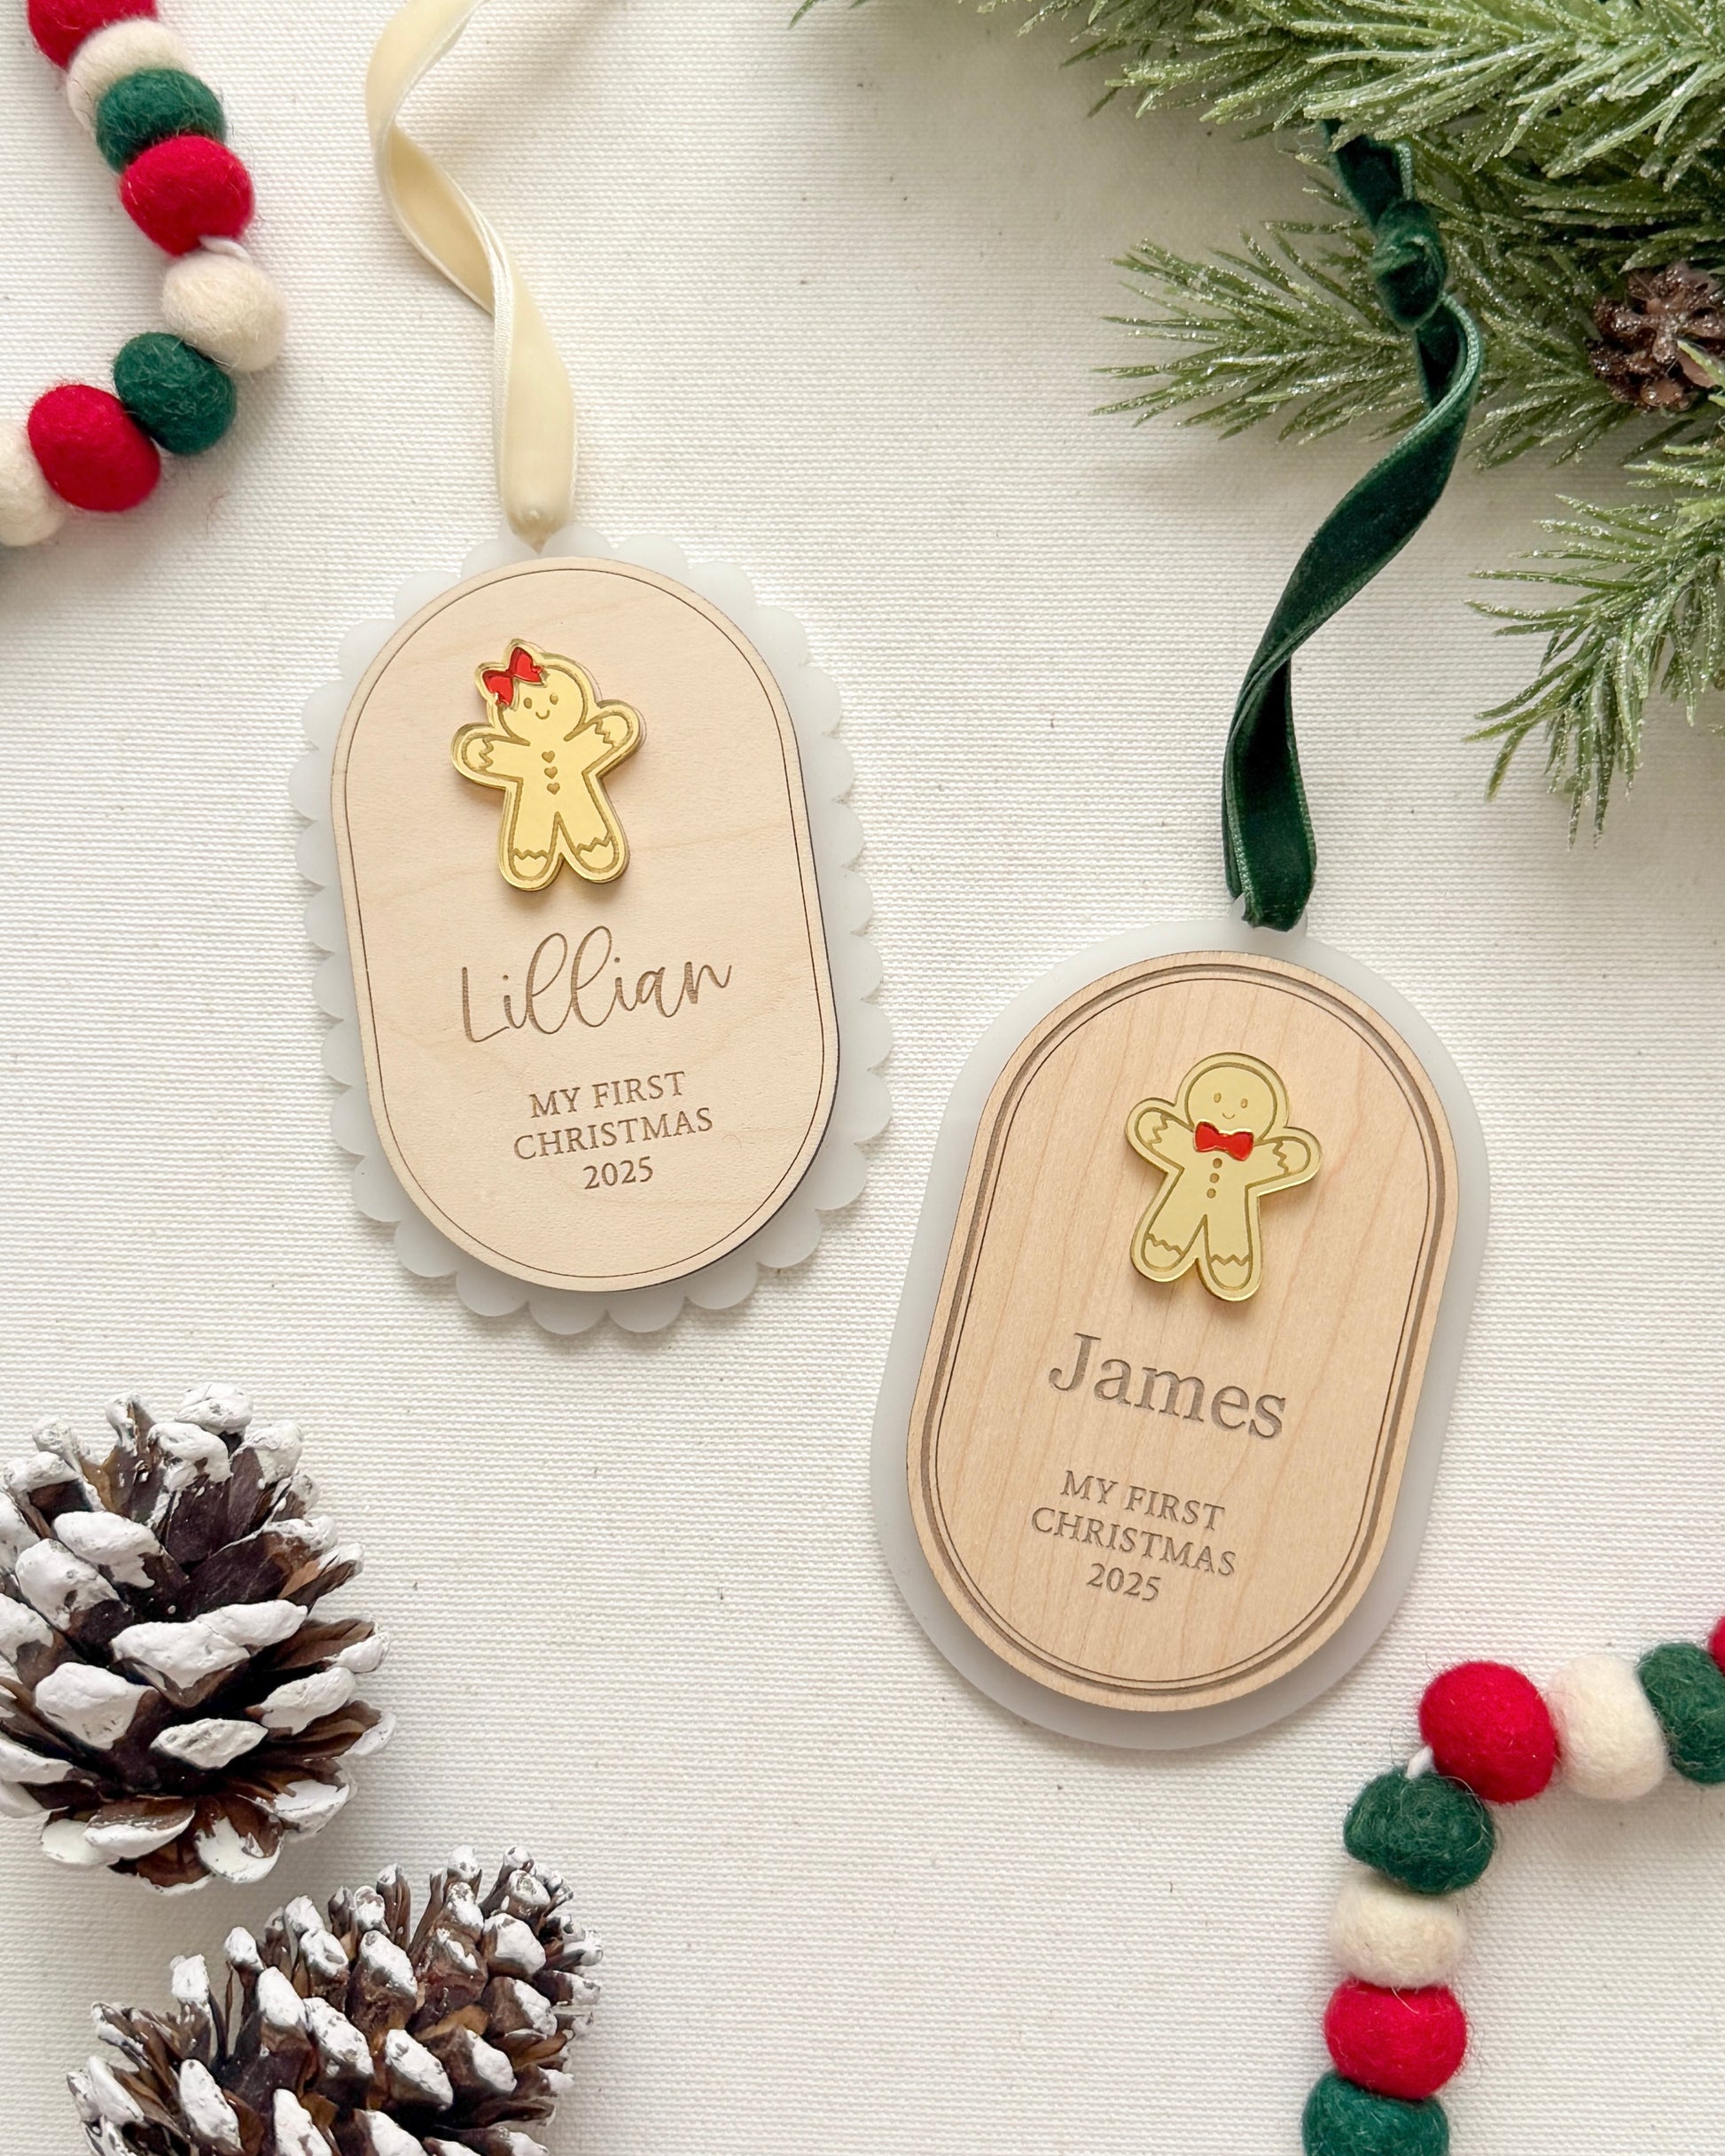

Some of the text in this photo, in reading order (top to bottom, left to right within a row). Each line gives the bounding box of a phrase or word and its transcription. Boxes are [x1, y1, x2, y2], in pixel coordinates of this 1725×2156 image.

[461, 925, 733, 1043] Lillian
[528, 1070, 686, 1119] MY FIRST
[512, 1106, 714, 1160] CHRISTMAS
[582, 1155, 654, 1191] 2025
[1048, 1332, 1287, 1441] James
[1059, 1469, 1226, 1532] MY FIRST
[1030, 1506, 1237, 1577] CHRISTMAS
[1085, 1562, 1162, 1603] 2025
